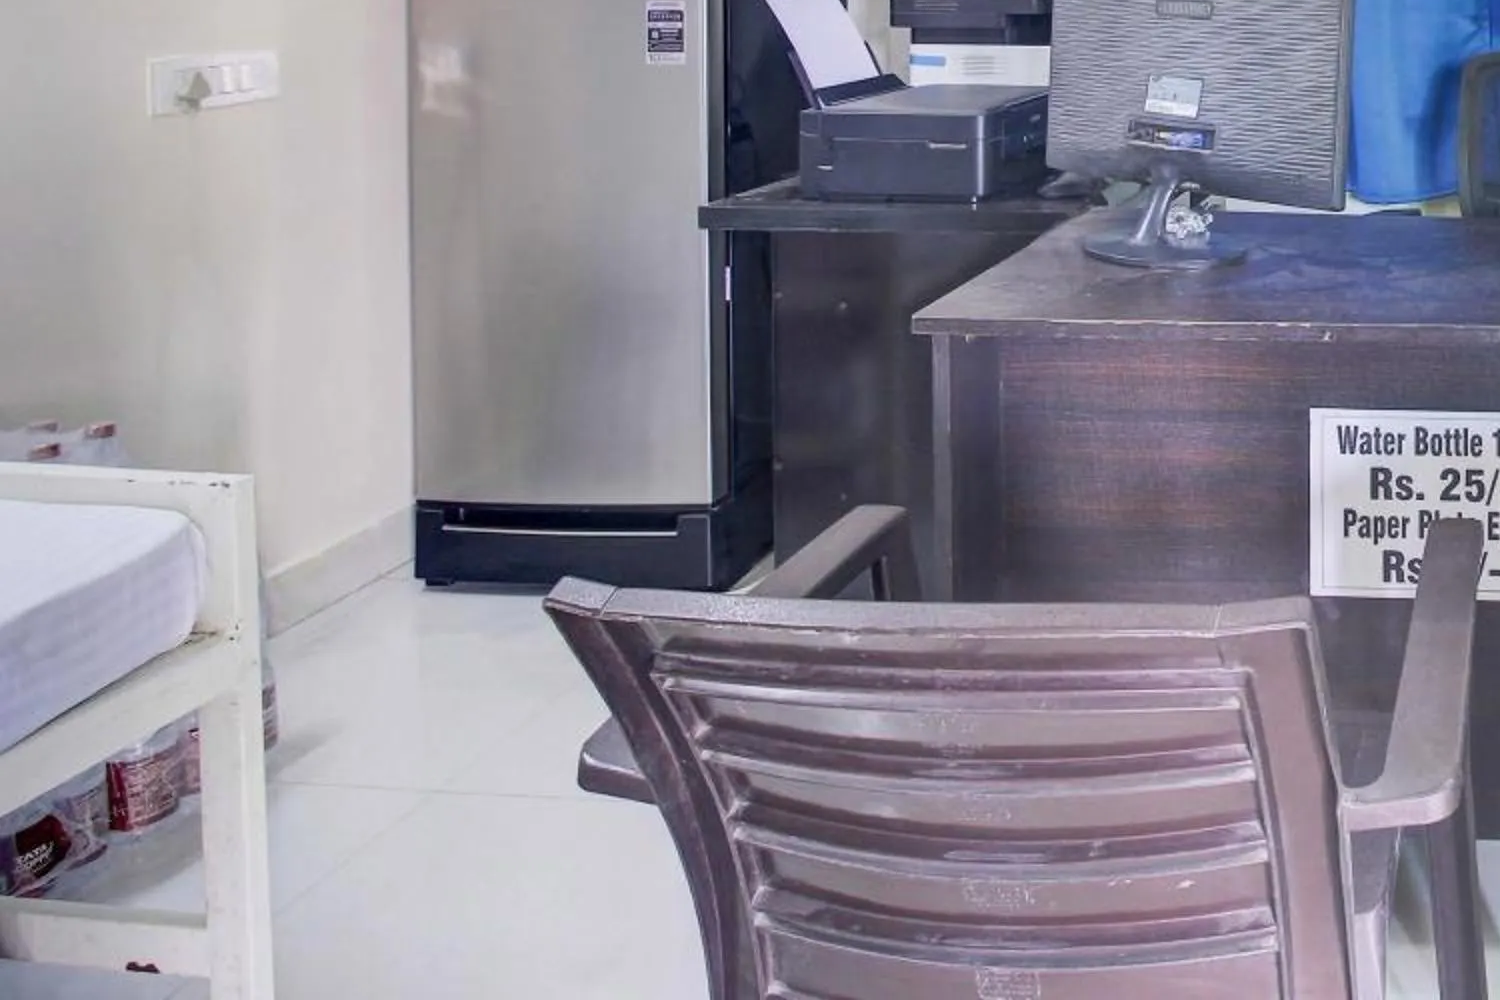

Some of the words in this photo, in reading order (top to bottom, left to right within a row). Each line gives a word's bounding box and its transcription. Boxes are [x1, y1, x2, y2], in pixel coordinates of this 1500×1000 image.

[1337, 425, 1406, 455] Water
[1414, 426, 1483, 457] Bottle
[1370, 466, 1425, 501] Rs.
[1343, 508, 1410, 545] Paper
